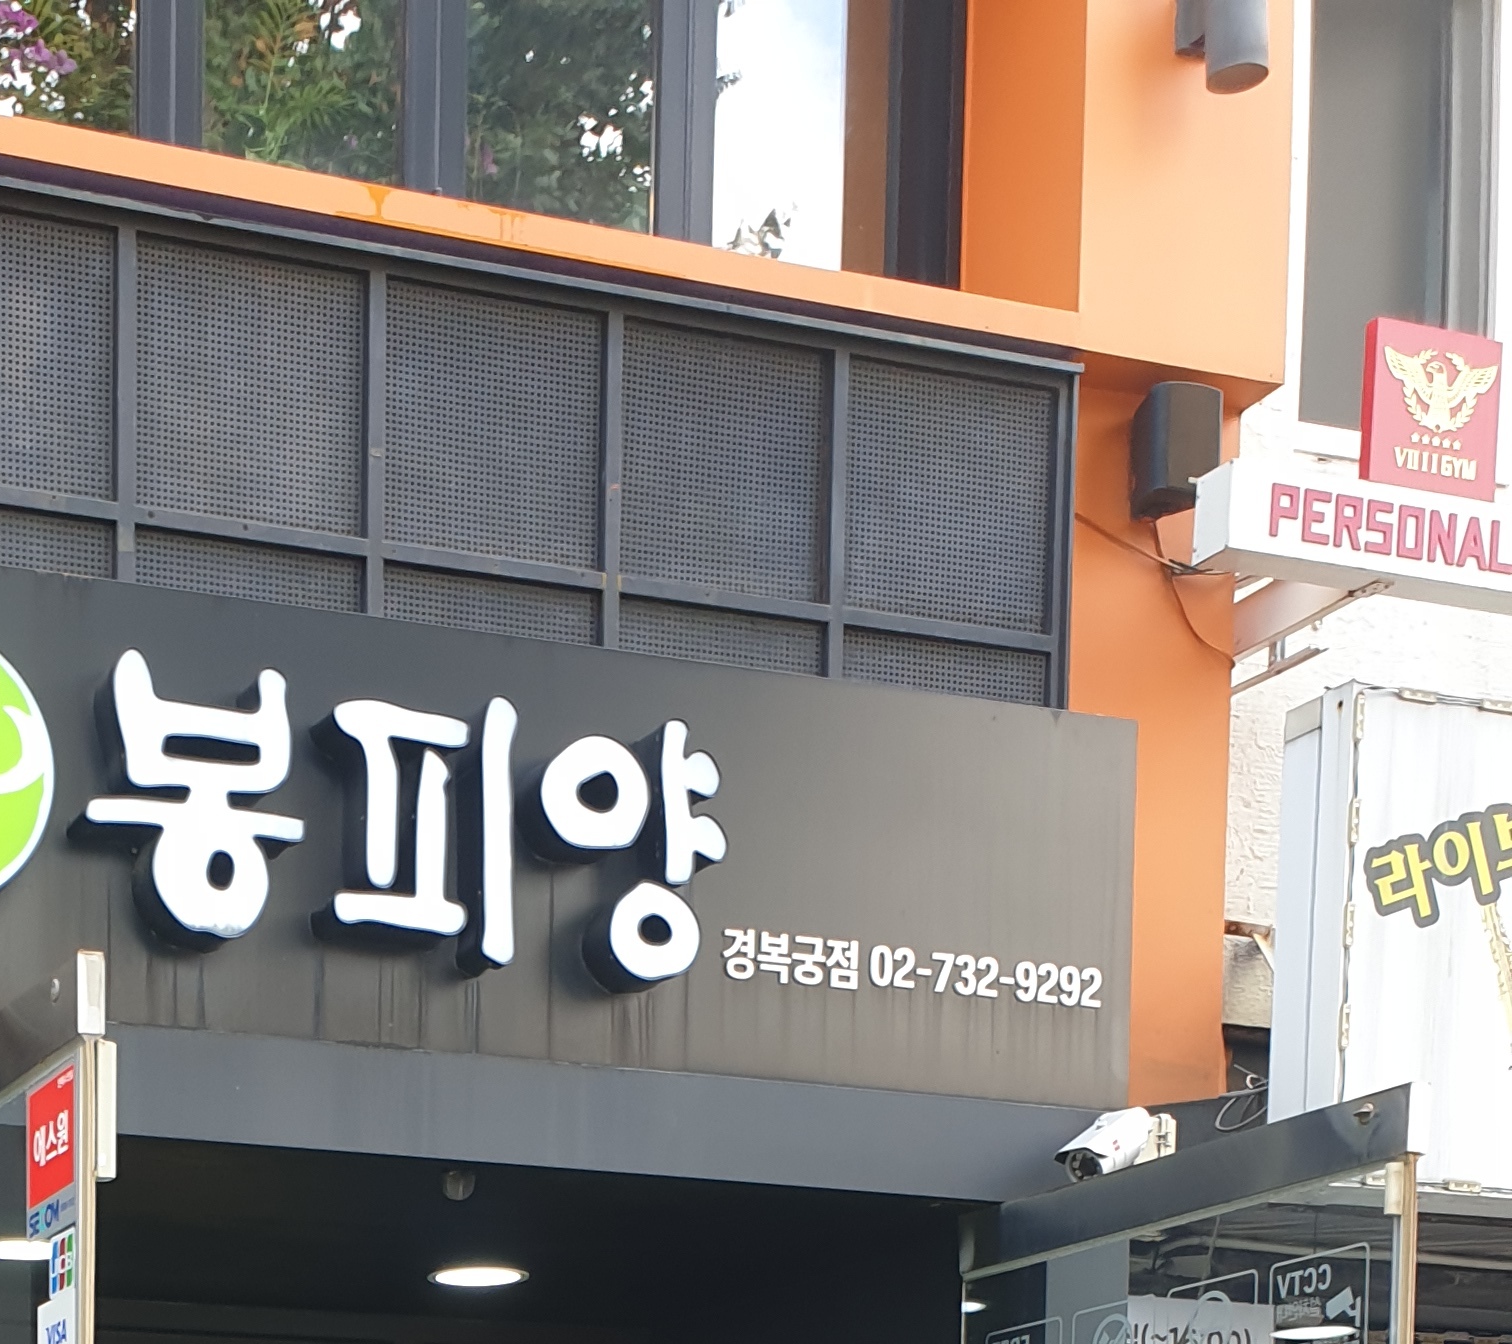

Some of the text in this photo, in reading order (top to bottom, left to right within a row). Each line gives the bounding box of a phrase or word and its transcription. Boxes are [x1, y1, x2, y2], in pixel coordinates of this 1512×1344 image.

[82, 645, 730, 985] 봉피양
[722, 927, 1104, 1009] 경복궁점 02-732-9292
[33, 1109, 69, 1167] 에스원
